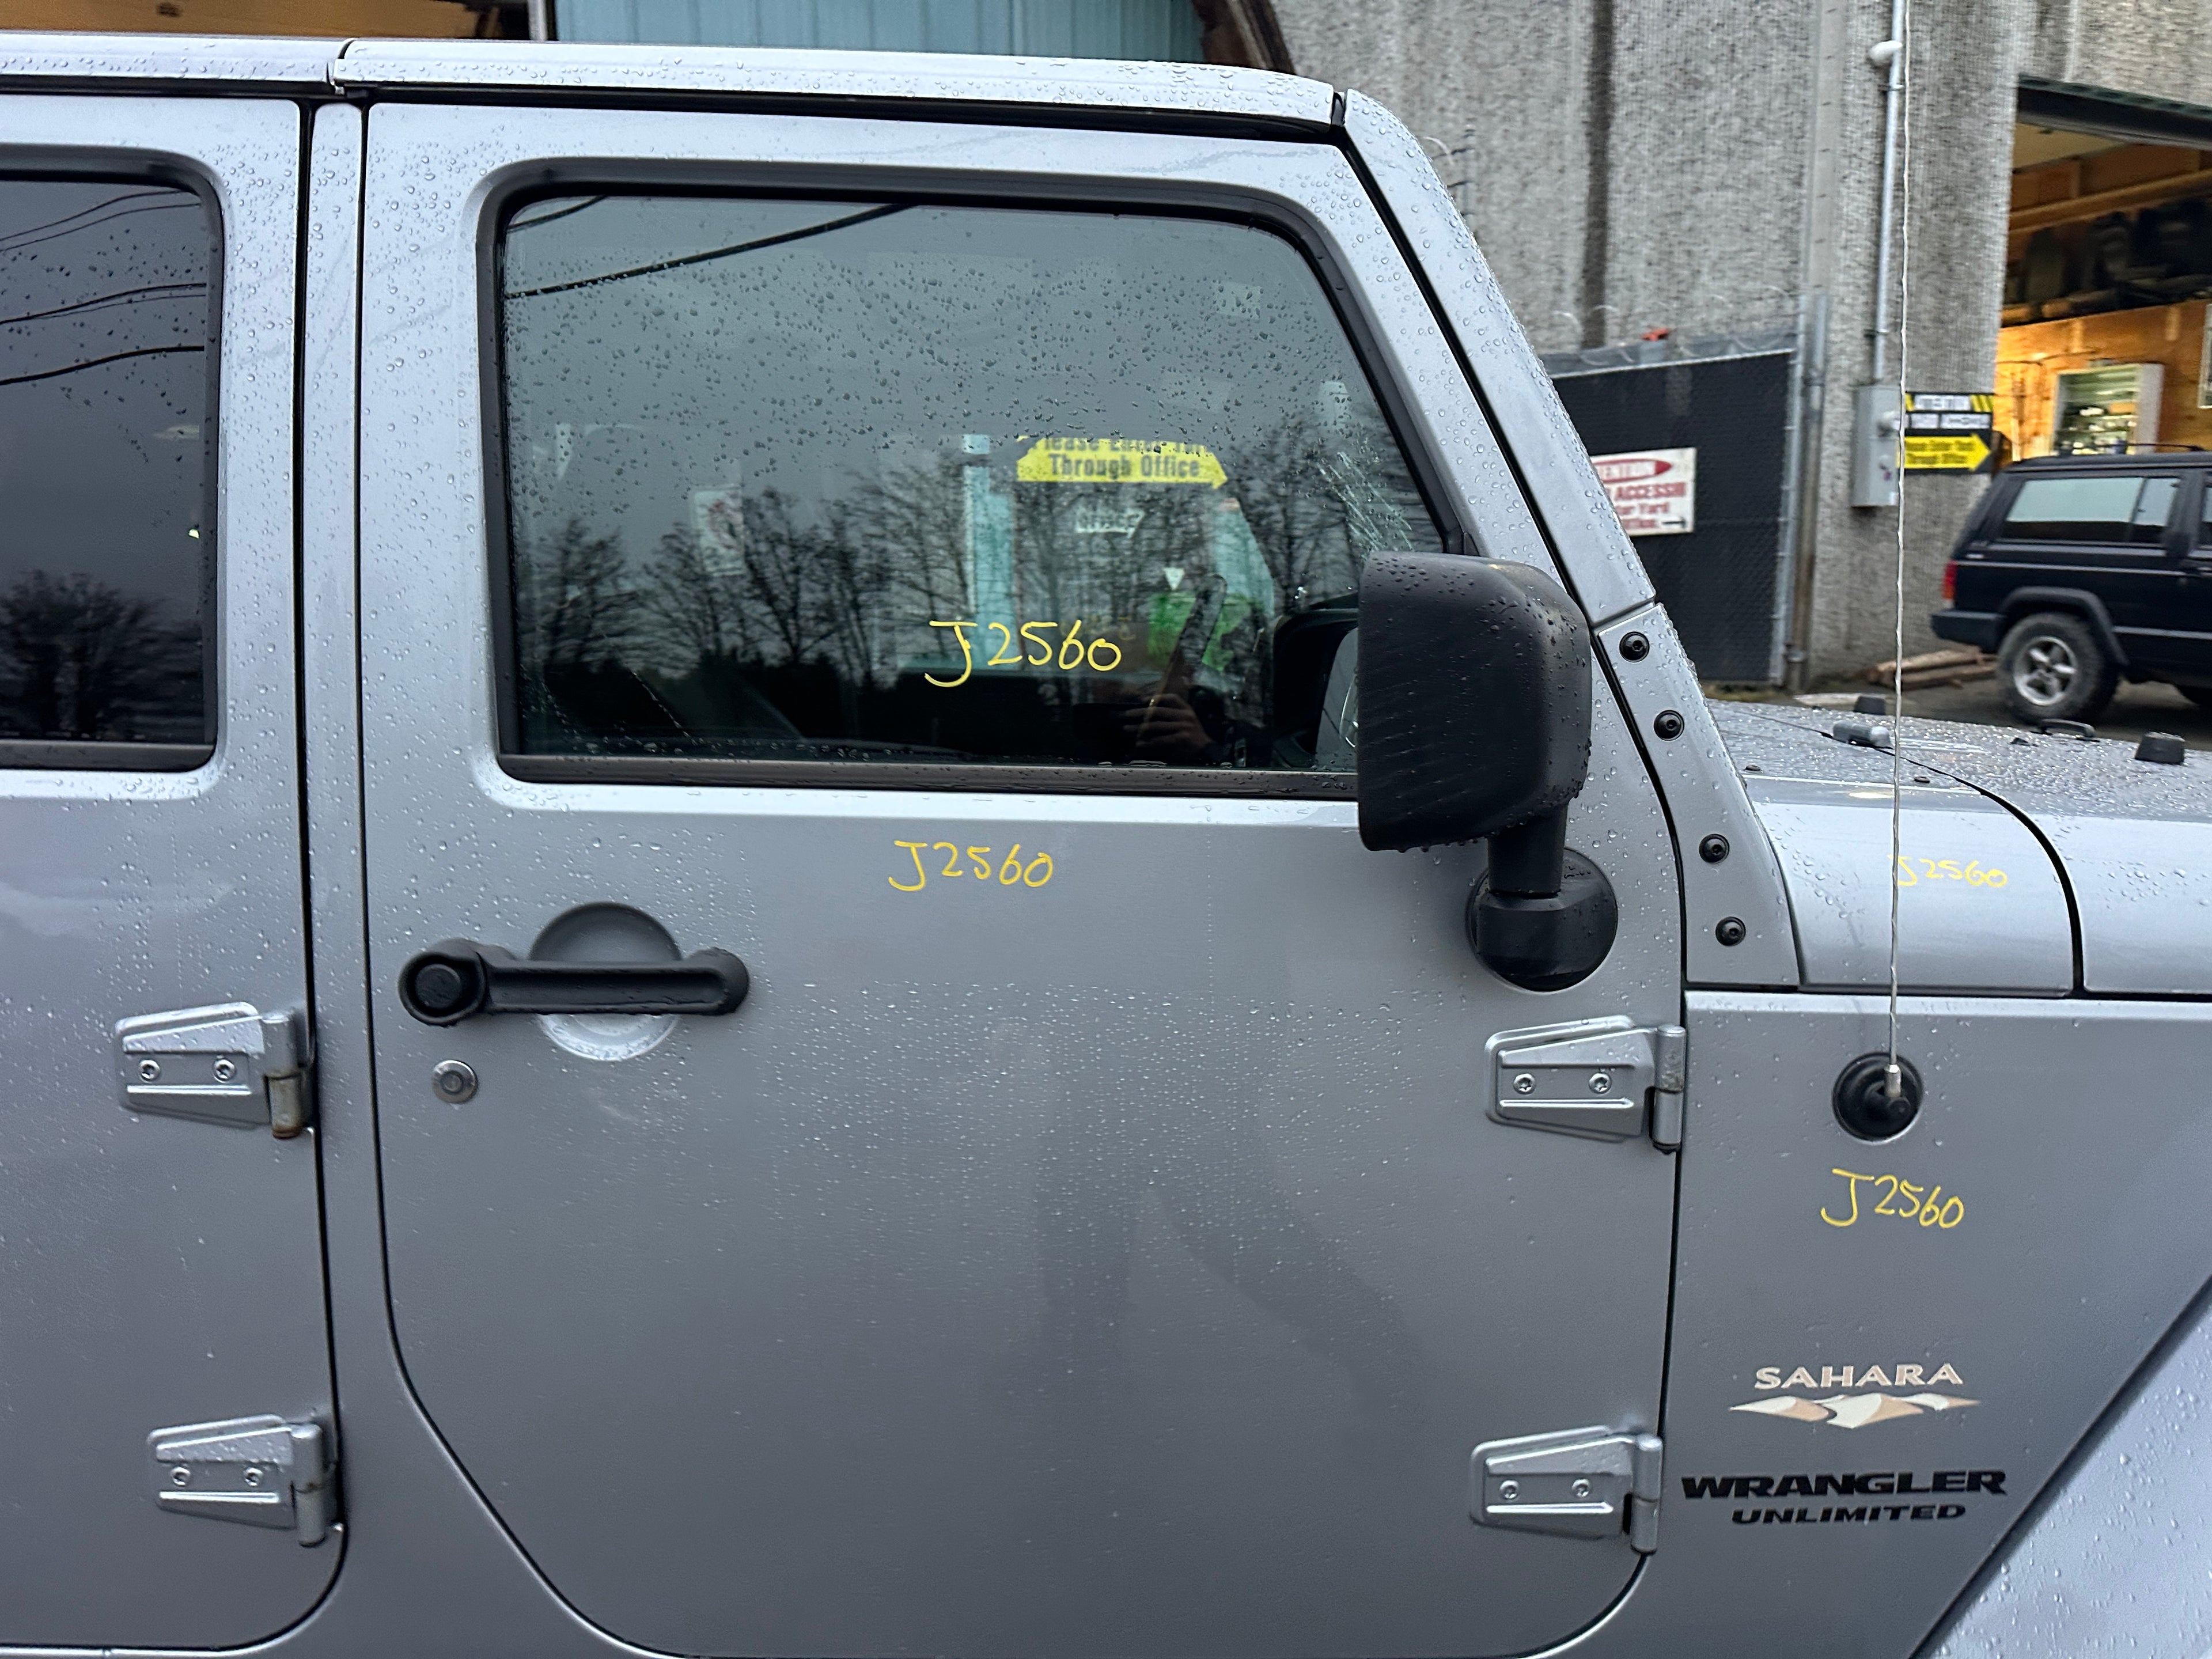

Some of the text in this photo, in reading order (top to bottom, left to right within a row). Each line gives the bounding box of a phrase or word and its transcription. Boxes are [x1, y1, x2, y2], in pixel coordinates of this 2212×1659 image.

[1049, 453, 1200, 480] Through Office
[925, 619, 1122, 688] J2560
[888, 840, 1054, 891] J2560
[1887, 854, 2008, 887] J2560
[1820, 1168, 1964, 1228] J2560
[1754, 1363, 1964, 1389] SAHARA
[1680, 1469, 2009, 1499] WRANGLER
[1731, 1504, 1966, 1525] UNLIMITED
